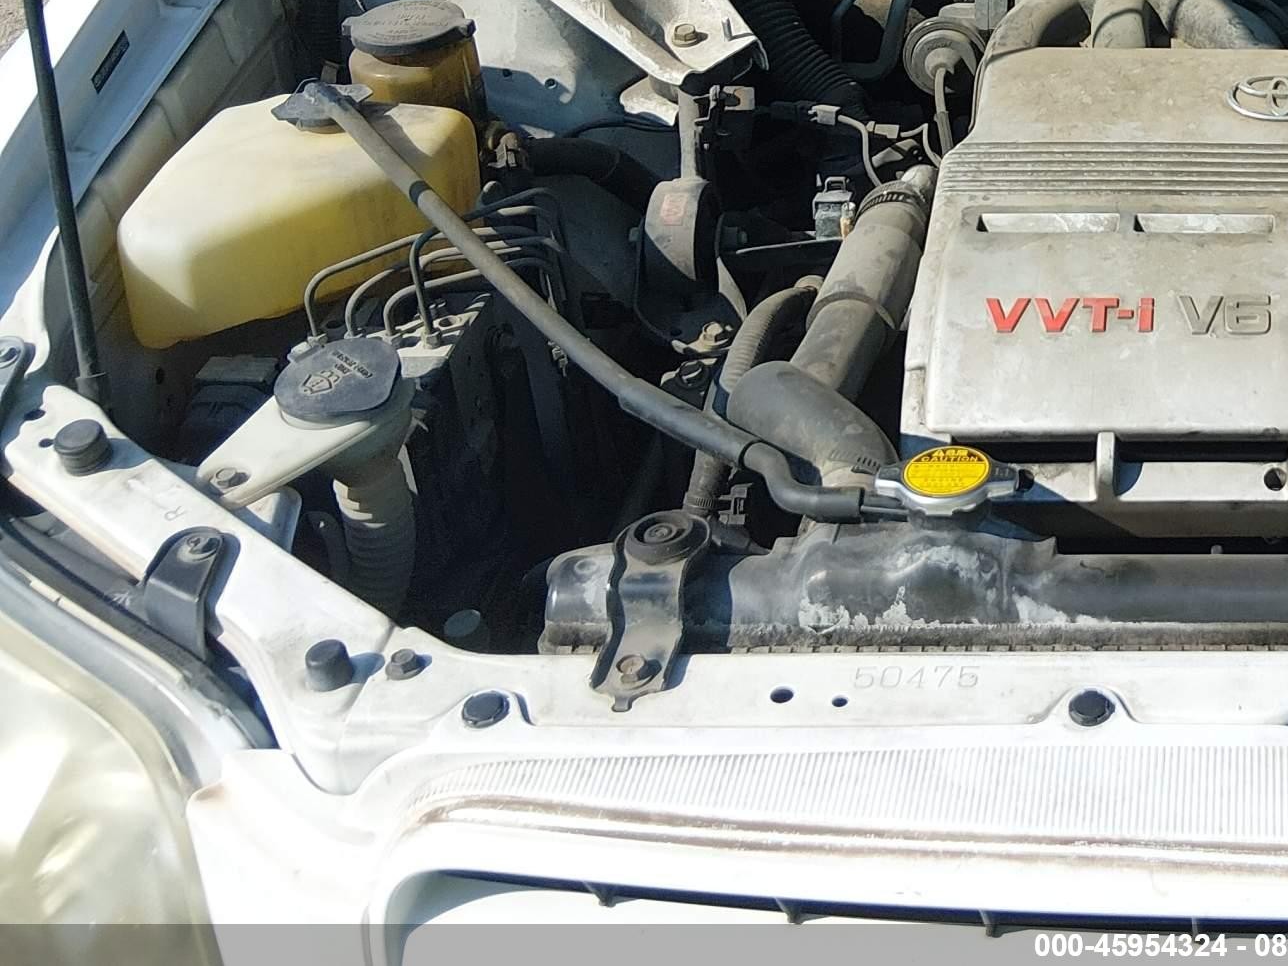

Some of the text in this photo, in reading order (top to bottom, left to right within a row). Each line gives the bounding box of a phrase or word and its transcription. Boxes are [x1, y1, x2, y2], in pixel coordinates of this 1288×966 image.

[985, 297, 1156, 333] VVT-i
[1176, 294, 1272, 335] V6
[853, 665, 981, 689] 50475
